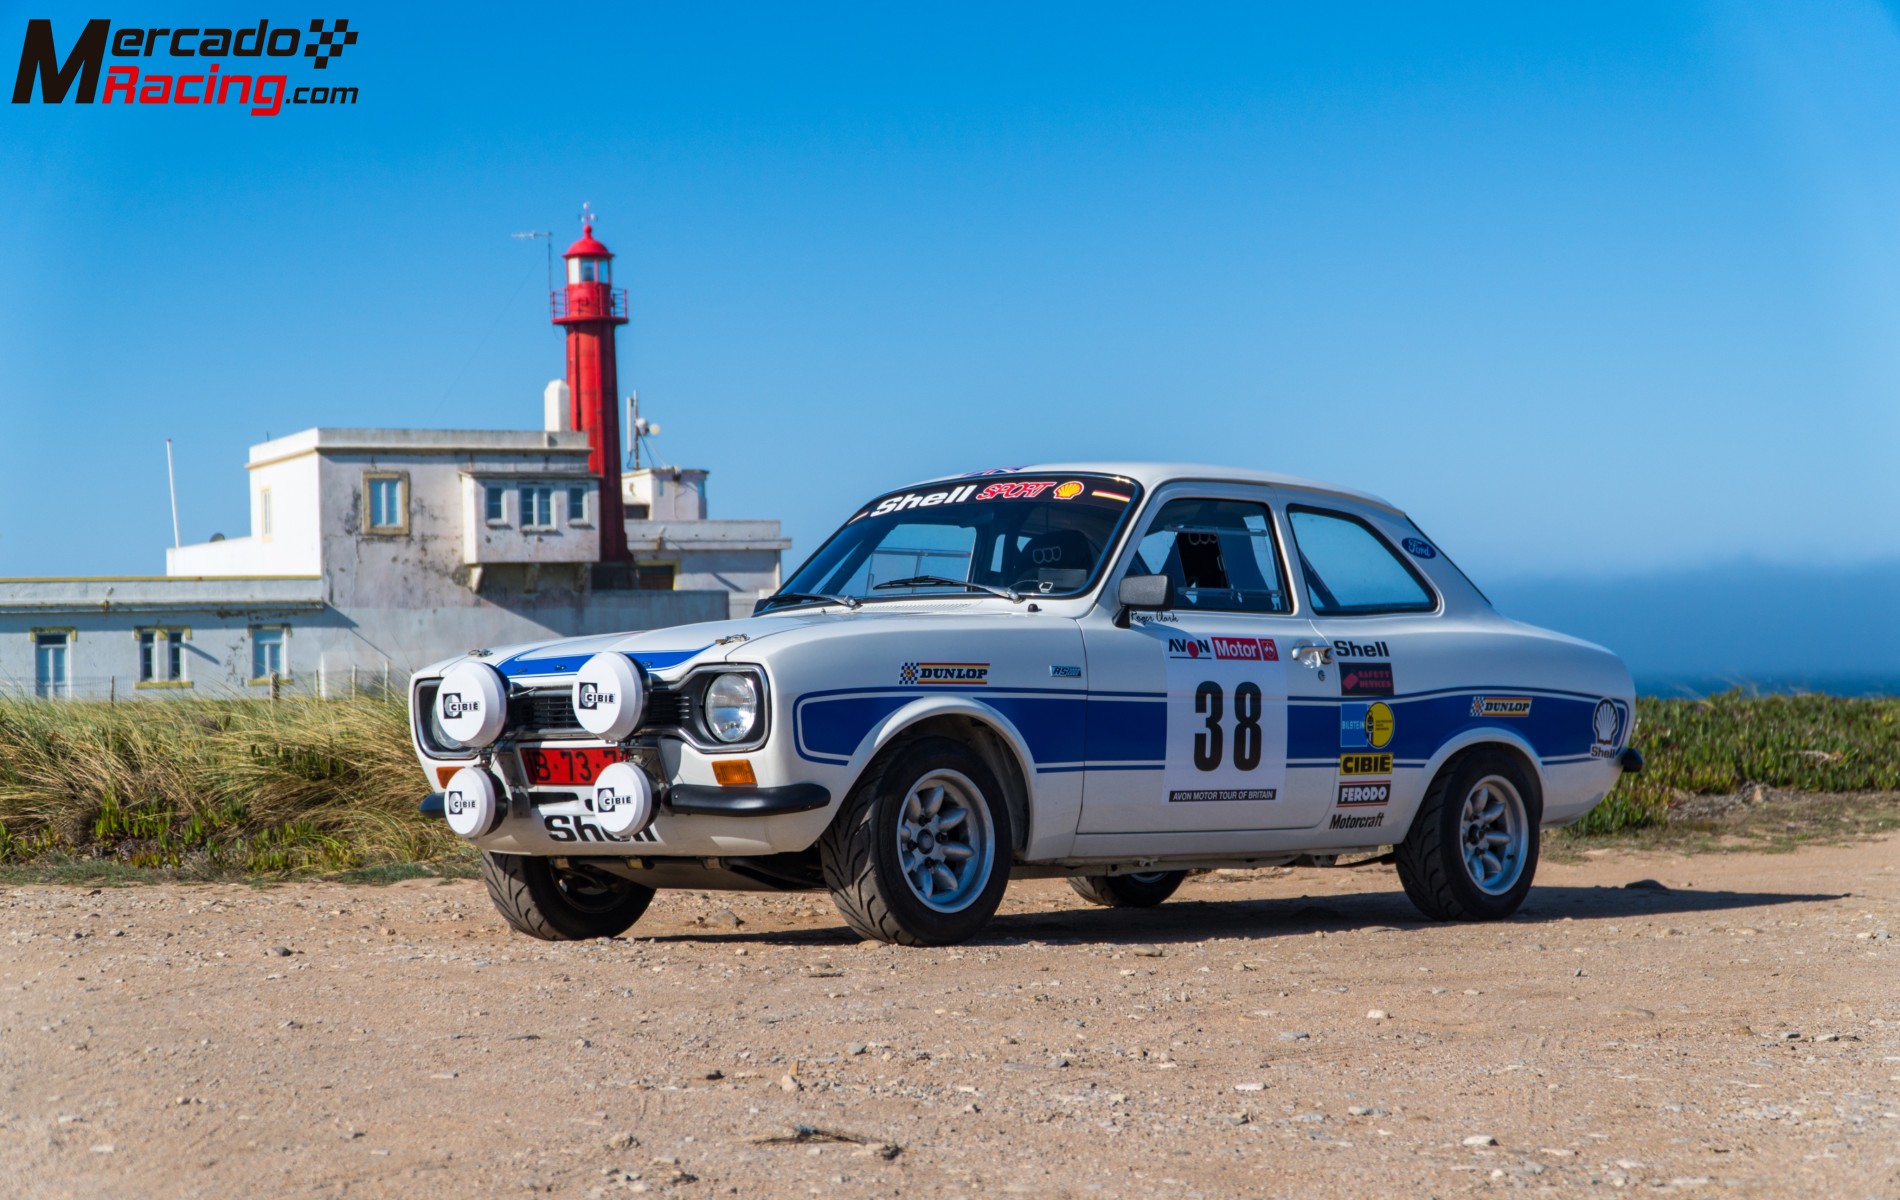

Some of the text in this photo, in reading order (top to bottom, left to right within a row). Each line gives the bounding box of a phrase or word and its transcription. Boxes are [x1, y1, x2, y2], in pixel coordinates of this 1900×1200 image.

[870, 481, 1057, 517] Shell SPORT
[1408, 539, 1431, 557] Ford
[1168, 638, 1257, 658] AVON Motor
[1334, 641, 1389, 657] Shell
[920, 668, 988, 679] DUNLOP
[1485, 702, 1530, 712] DUNLOP
[1194, 681, 1262, 772] 38
[1591, 746, 1616, 759] Shell
[1173, 790, 1273, 800] AVON MOTOR TOUR OF BRITAIN
[1341, 786, 1387, 802] FERODO
[1329, 812, 1384, 830] Motorcraft
